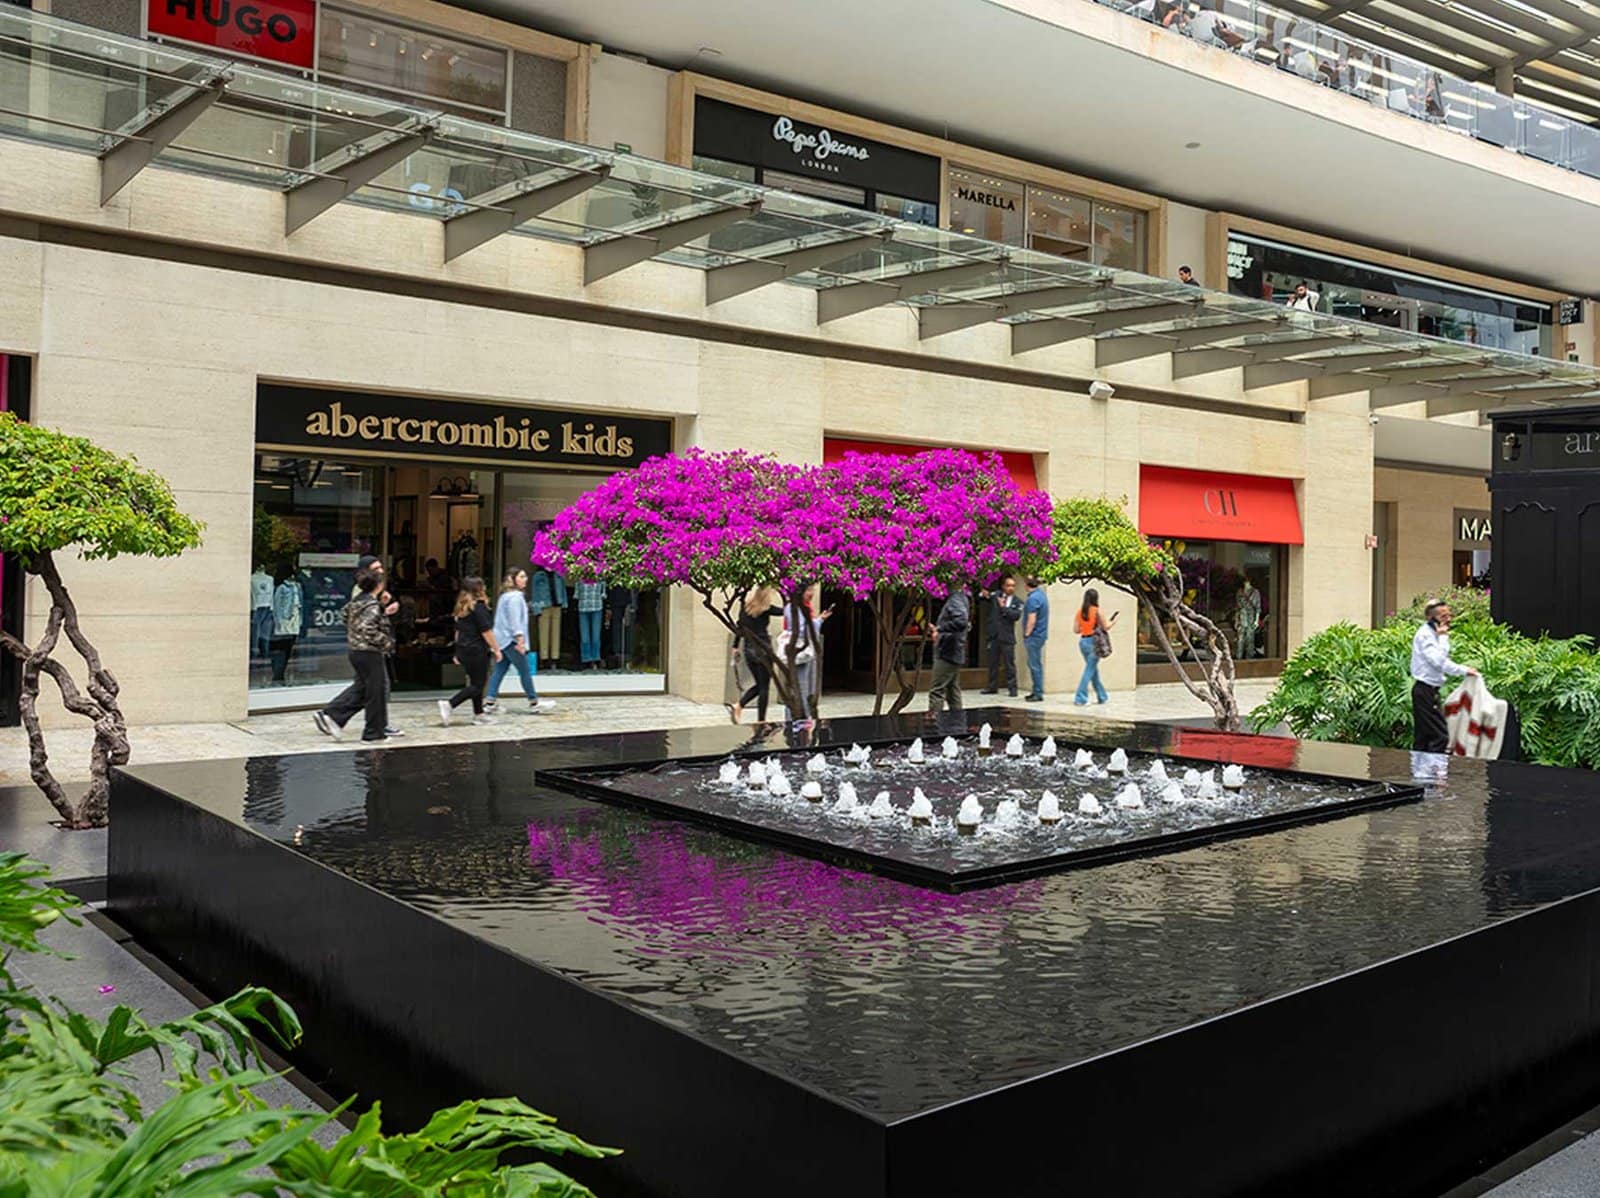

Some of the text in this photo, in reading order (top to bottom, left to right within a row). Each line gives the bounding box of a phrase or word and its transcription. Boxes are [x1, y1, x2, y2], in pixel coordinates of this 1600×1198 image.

[167, 0, 297, 43] HUGO
[773, 116, 870, 160] Pepe Jeans
[801, 159, 839, 172] LONDON
[958, 186, 1015, 211] MARELLA
[306, 402, 635, 458] abercrombie kids
